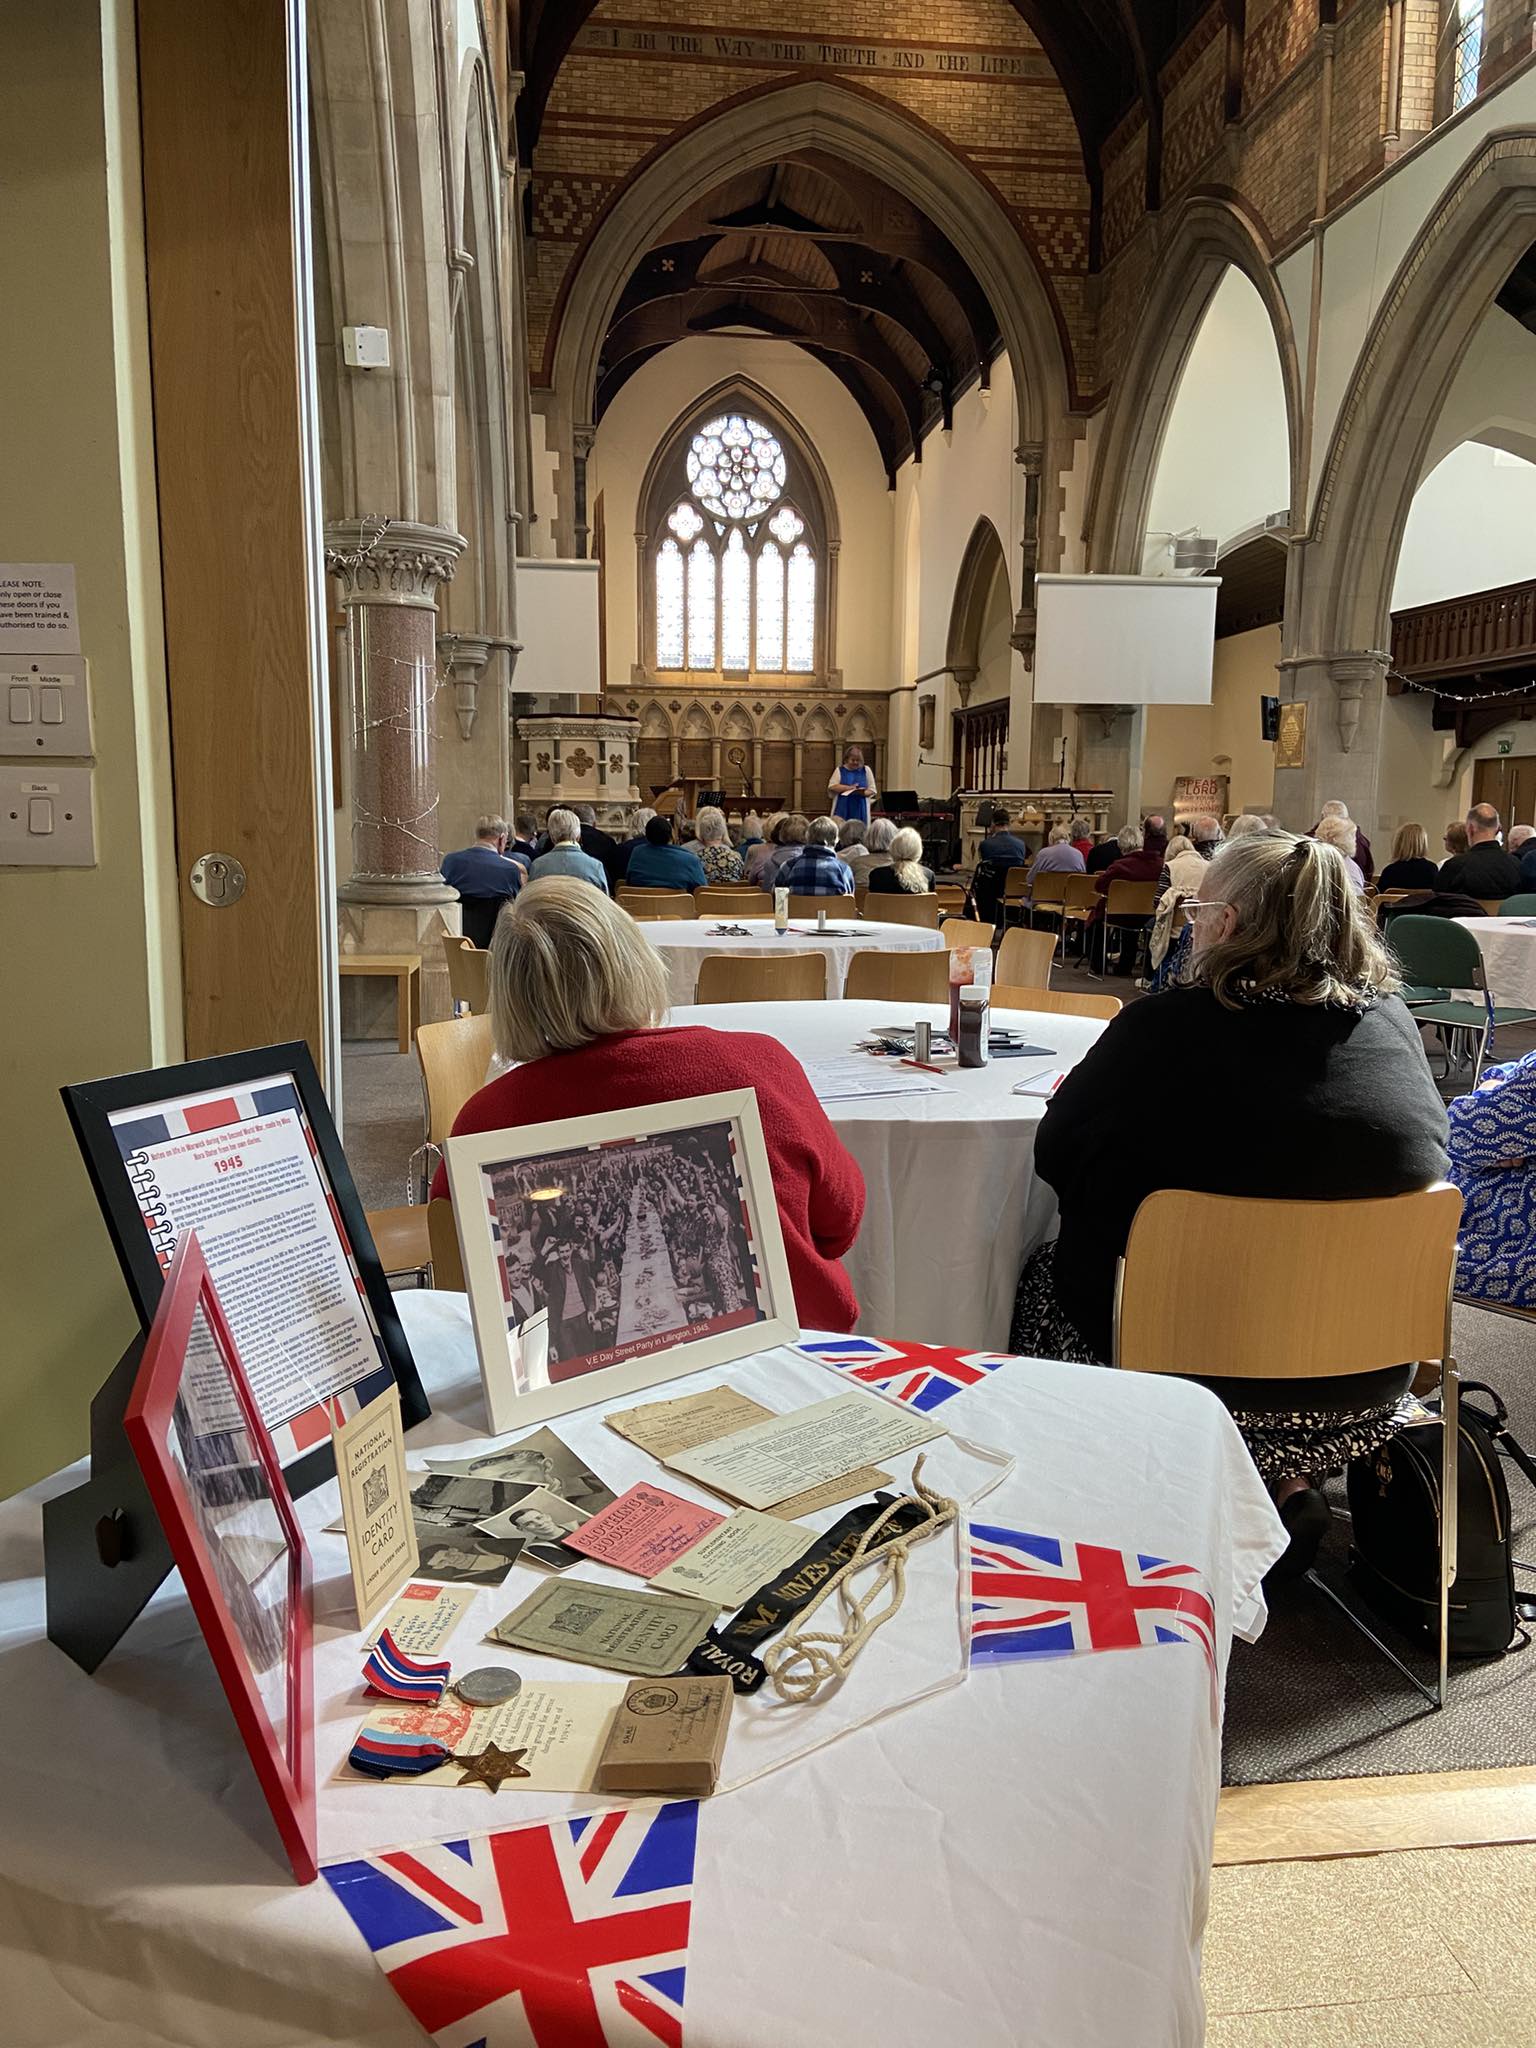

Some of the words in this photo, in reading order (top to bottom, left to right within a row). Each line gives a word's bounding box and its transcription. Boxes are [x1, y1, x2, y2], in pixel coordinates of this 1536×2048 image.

[668, 34, 703, 54] THE
[714, 37, 755, 57] WAY
[771, 43, 805, 61] THE
[818, 44, 877, 66] TRUTH
[892, 52, 924, 68] AND
[936, 54, 969, 72] THE
[981, 56, 1022, 74] LIFE
[0, 580, 20, 588] EASE
[0, 591, 11, 599] nly
[13, 592, 32, 600] open
[43, 591, 62, 599] close
[15, 611, 34, 619] been
[46, 602, 60, 610] you
[47, 621, 57, 629] do
[1186, 786, 1218, 796] LORD
[213, 1155, 243, 1173] 1945
[600, 1352, 614, 1362] Day
[615, 1346, 636, 1357] Street
[636, 1341, 654, 1352] Party
[351, 1435, 392, 1478] REGISTRATION
[354, 1429, 386, 1461] NATIONAL
[362, 1500, 398, 1547] IDENTITY
[575, 1497, 643, 1548] CLOTHING
[371, 1526, 395, 1556] CARD
[589, 1525, 633, 1554] BOOK
[698, 1526, 733, 1555] SUPPLEMENTARY
[702, 1540, 727, 1559] CLOTHING
[366, 1569, 379, 1586] UNDER
[380, 1553, 395, 1572] SIXTEEN
[600, 1612, 632, 1645] NATIONAL
[606, 1607, 649, 1653] REGISTRATION
[625, 1613, 667, 1654] IDENTITY
[650, 1624, 678, 1650] CARD
[700, 1643, 759, 1685] ROYAL
